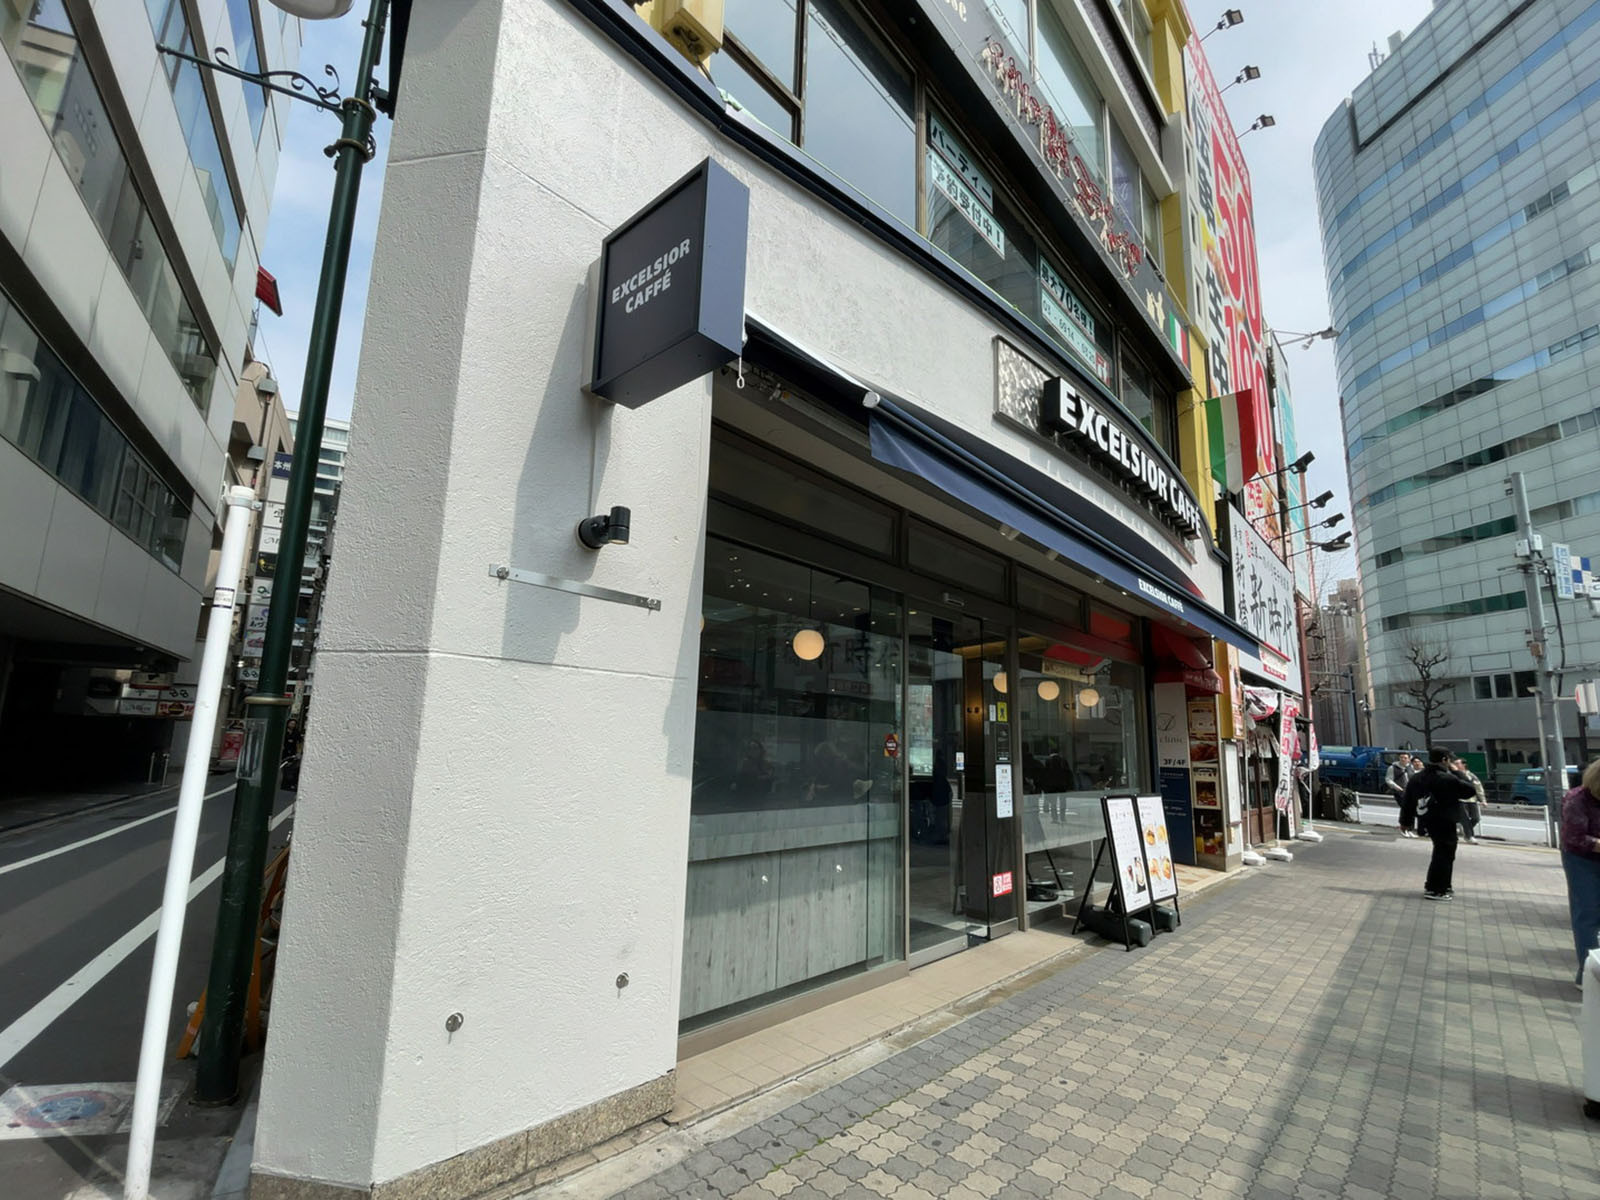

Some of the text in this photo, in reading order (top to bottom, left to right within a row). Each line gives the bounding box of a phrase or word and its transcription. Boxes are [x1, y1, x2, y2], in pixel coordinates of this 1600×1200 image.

[612, 238, 691, 304] EXCELSIOR
[625, 268, 672, 314] CAFFÉ
[1059, 376, 1203, 537] EXCELSIOR CAFFÉ
